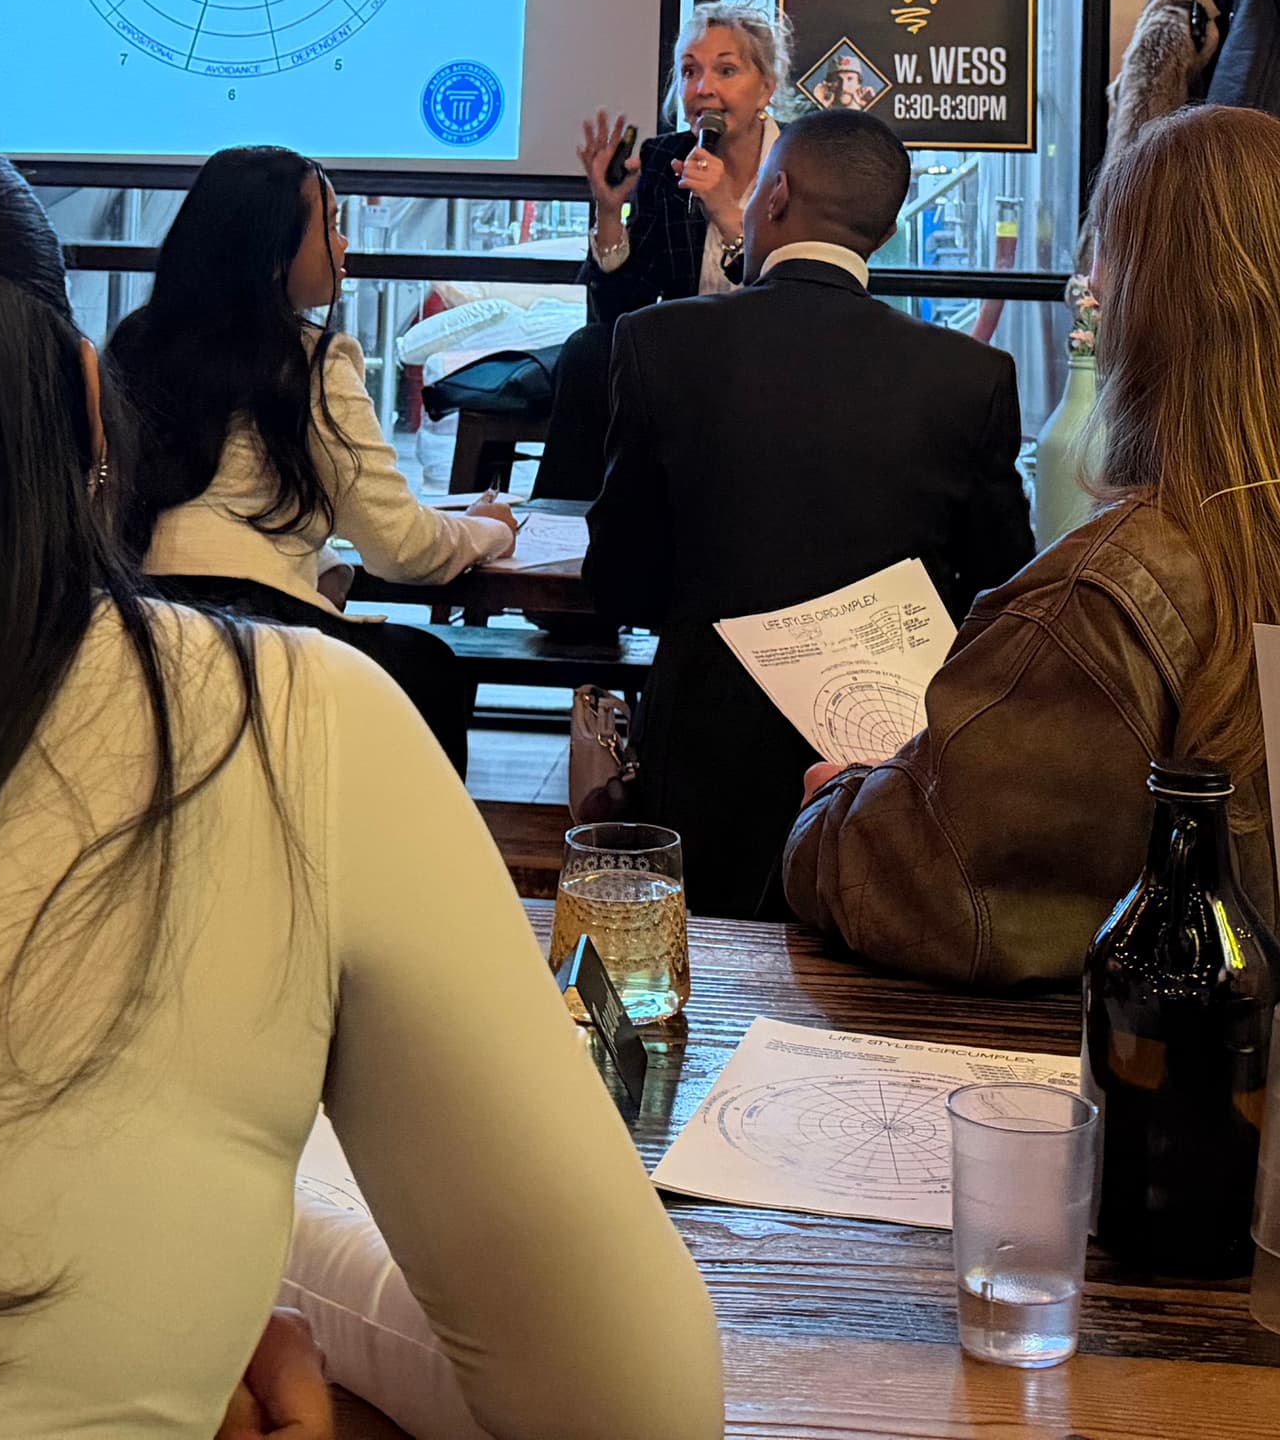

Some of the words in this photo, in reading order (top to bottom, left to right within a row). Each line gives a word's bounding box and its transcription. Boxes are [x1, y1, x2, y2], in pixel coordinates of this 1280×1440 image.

[116, 20, 175, 62] OPPOSITIONAL
[290, 23, 354, 65] DEPENDENT
[119, 53, 129, 66] 7
[204, 64, 262, 75] AVOIDANCE
[334, 58, 343, 71] 5
[929, 46, 1007, 86] WESS
[227, 88, 236, 101] 6
[893, 93, 1008, 122] 6:30-8:30PM
[762, 618, 784, 631] LIFE
[783, 613, 816, 628] STYLES
[814, 592, 879, 622] CIRCUMPLEX
[828, 1033, 863, 1044] LIFE
[867, 1039, 925, 1051] STYLES
[927, 1046, 1037, 1064] CIRCUMPLEX
